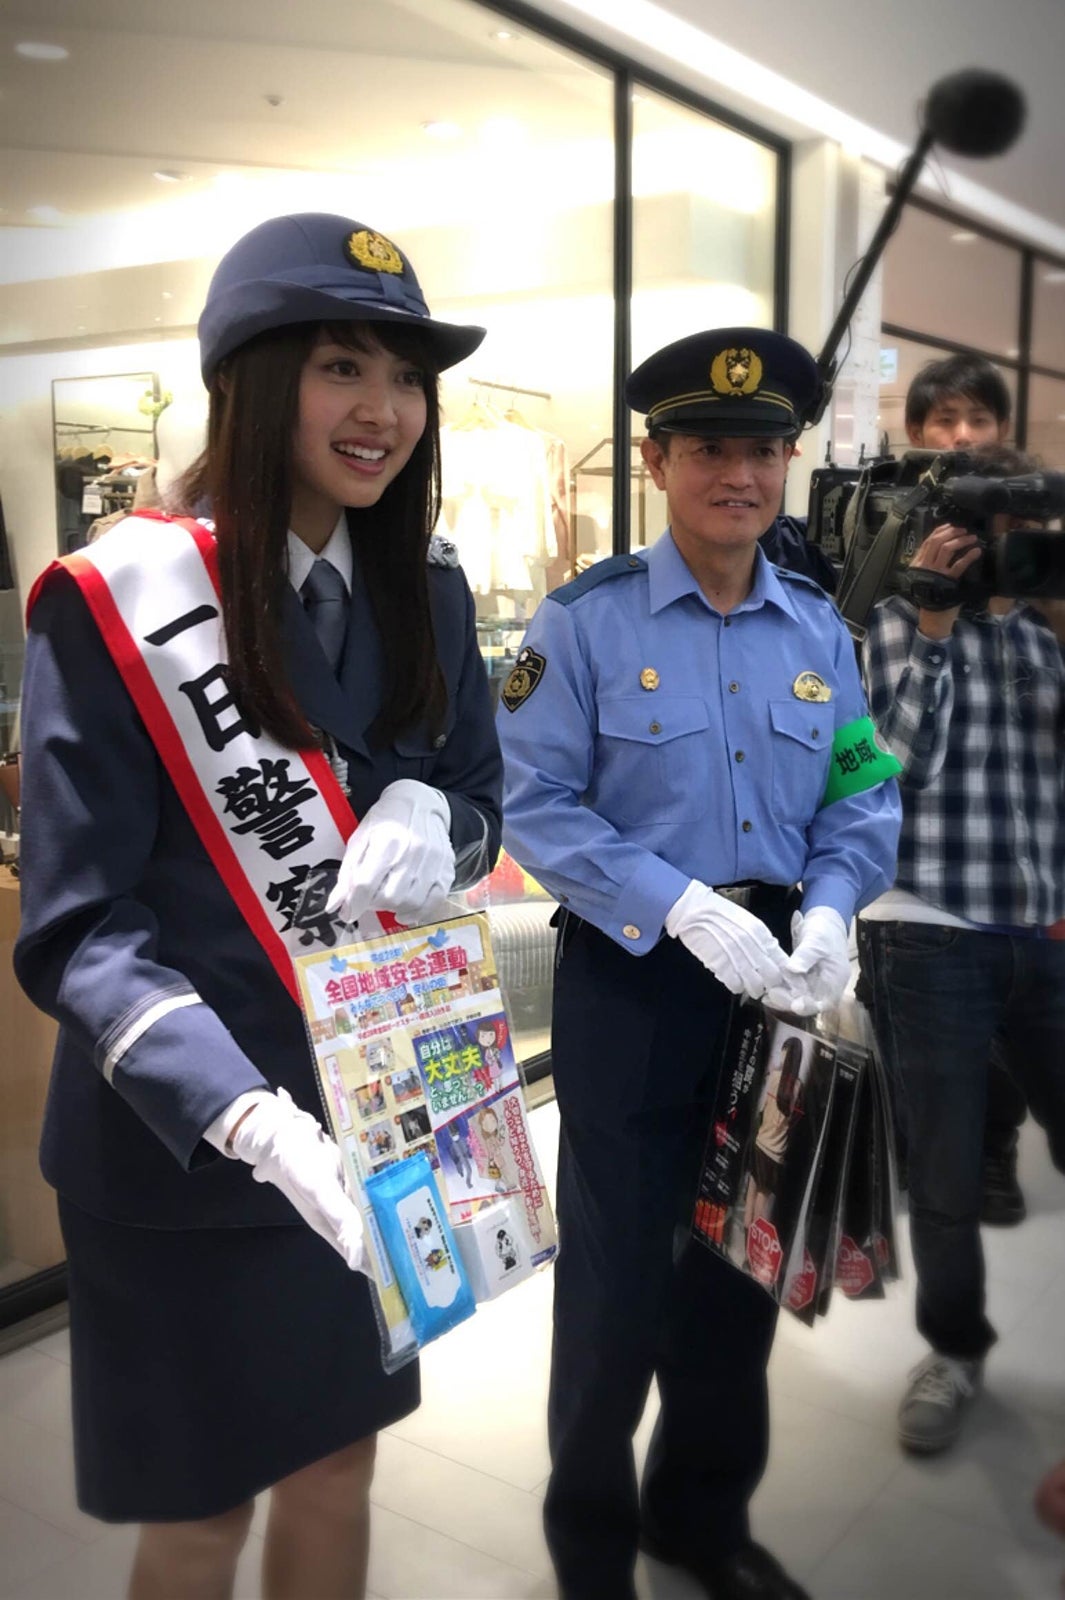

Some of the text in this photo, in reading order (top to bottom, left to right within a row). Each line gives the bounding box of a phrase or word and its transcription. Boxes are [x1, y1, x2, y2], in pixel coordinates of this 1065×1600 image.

[835, 738, 878, 775] 地域
[144, 604, 358, 947] 一日警察
[324, 945, 469, 1004] 全国地域安全運動
[419, 1035, 453, 1060] 自分は
[424, 1046, 483, 1084] 大丈夫
[750, 1222, 782, 1255] STOP
